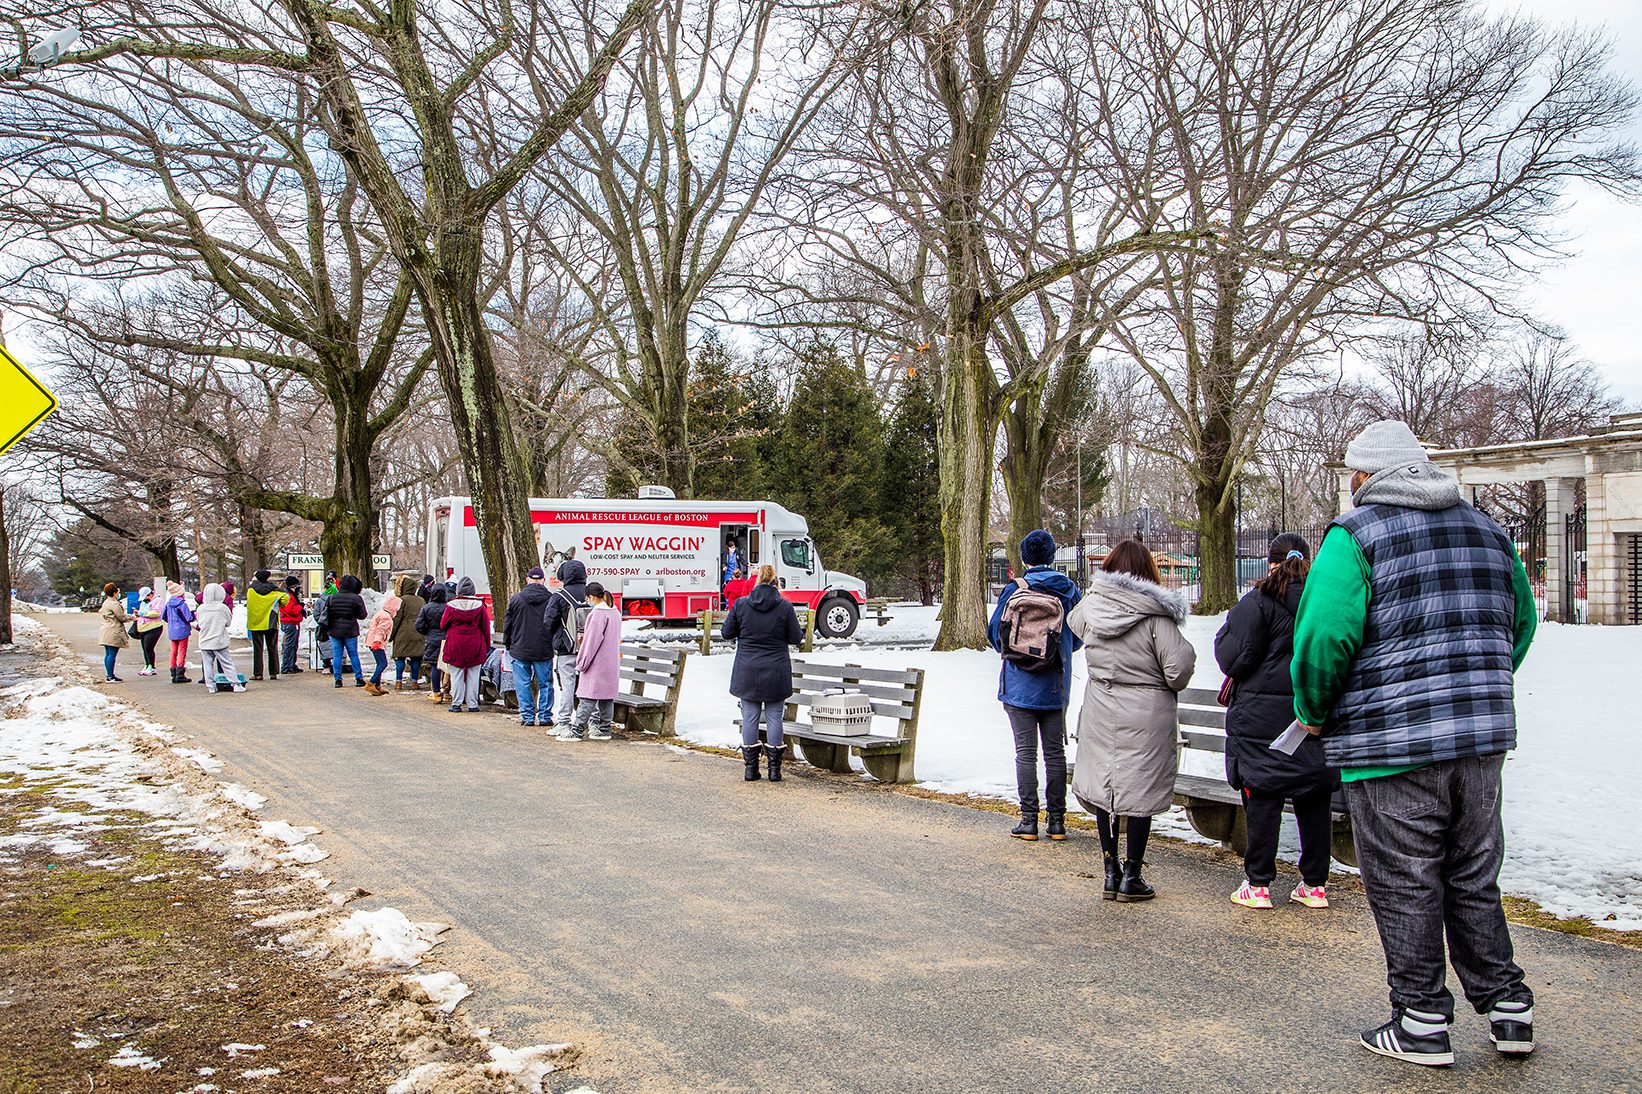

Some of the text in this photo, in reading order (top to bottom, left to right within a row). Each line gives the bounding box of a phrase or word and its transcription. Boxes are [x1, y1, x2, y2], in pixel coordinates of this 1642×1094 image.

[593, 513, 626, 521] RESCUE
[629, 513, 661, 521] LEAGUE
[675, 513, 708, 521] BOSTON
[584, 536, 705, 551] SPAY WAGGIN'
[292, 556, 387, 564] FRANK OO
[655, 567, 705, 577] arlboston.org
